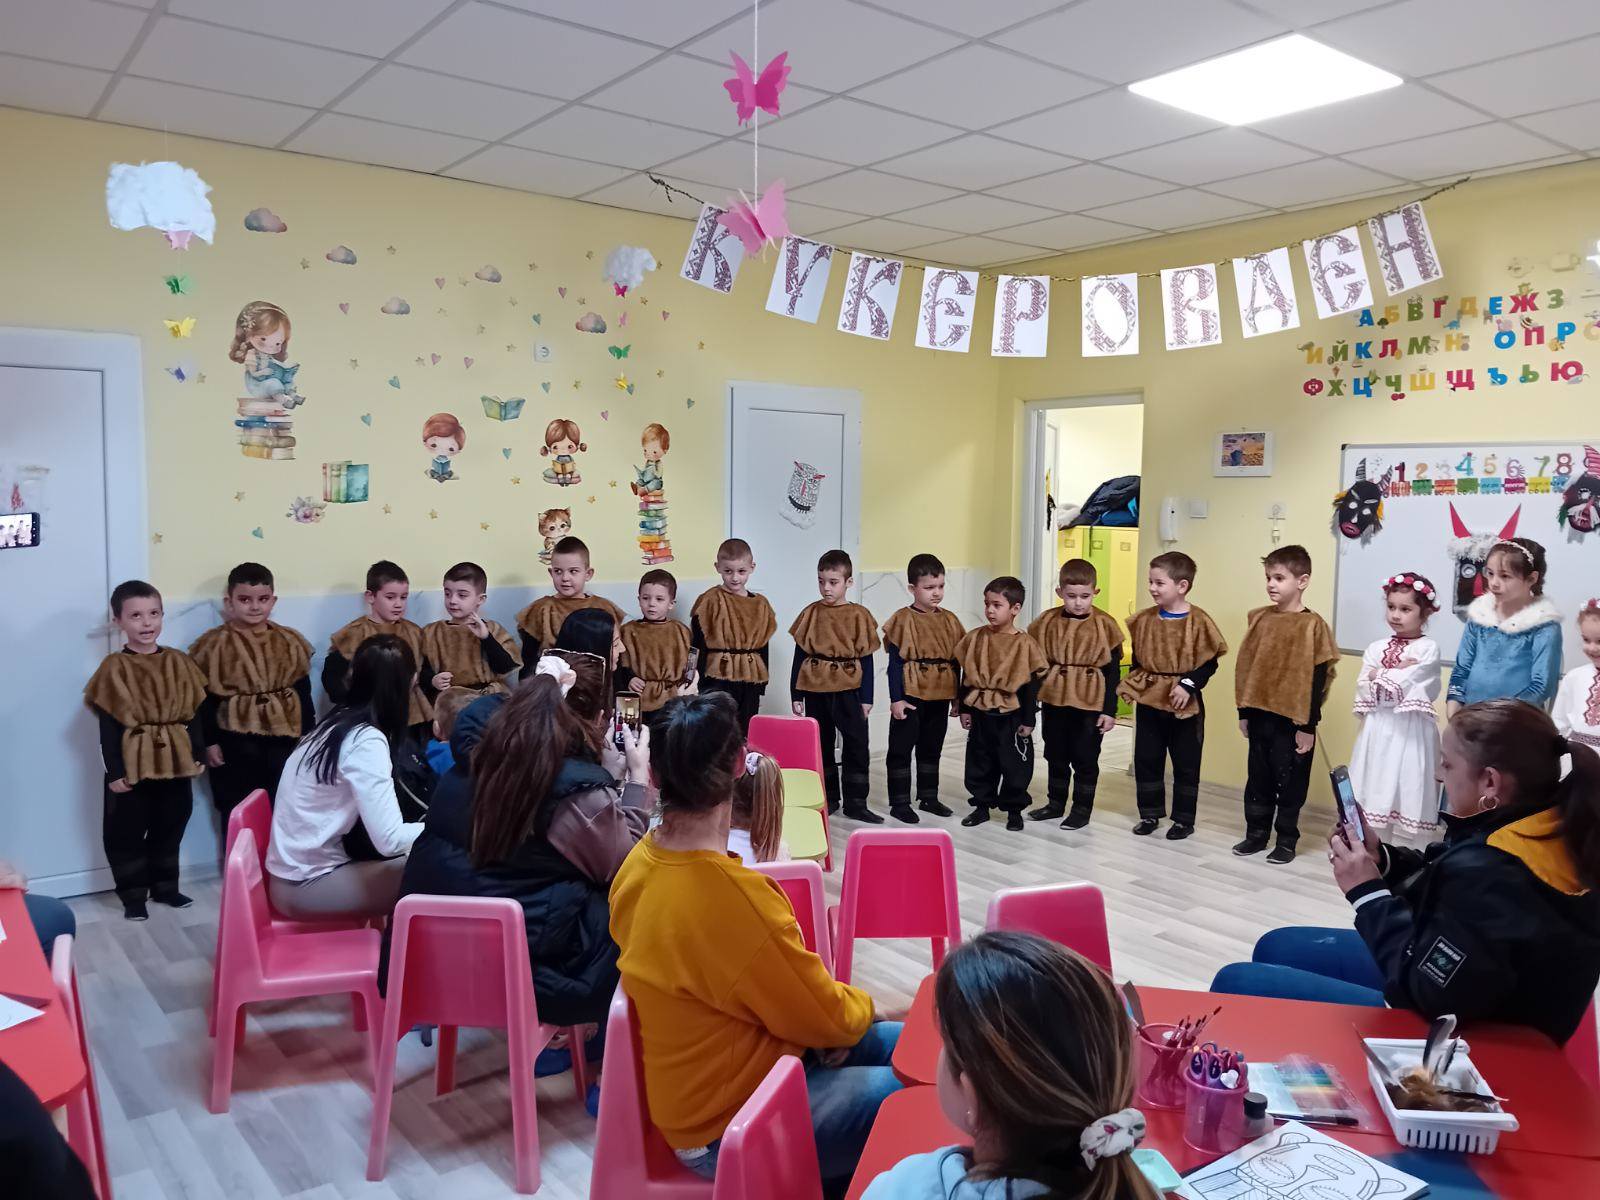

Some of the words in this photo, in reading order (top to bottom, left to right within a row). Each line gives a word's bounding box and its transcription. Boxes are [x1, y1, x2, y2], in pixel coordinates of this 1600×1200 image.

[1358, 309, 1374, 327] А
[1408, 302, 1424, 321] В
[1433, 298, 1448, 318] Г
[1489, 297, 1503, 315] Е
[1509, 292, 1539, 313] Ж
[1356, 342, 1373, 359] К
[1379, 339, 1399, 358] Л
[1407, 336, 1431, 355] М
[1494, 330, 1516, 349] О
[1524, 326, 1545, 346] П
[1557, 322, 1577, 341] Р
[1303, 378, 1324, 396] Ф
[1328, 379, 1344, 396] Х
[1353, 377, 1373, 397] Ц
[1385, 375, 1402, 392] Ч
[1410, 372, 1435, 391] Ш
[1447, 369, 1475, 390] Щ
[1488, 368, 1508, 386] Ъ
[1522, 364, 1540, 384] Ь
[1551, 361, 1584, 383] Ю
[1395, 461, 1405, 482] 1
[1416, 463, 1428, 480] 2
[1455, 452, 1473, 476] 4
[1484, 456, 1497, 475] 5
[1506, 459, 1520, 478] 6
[1534, 456, 1550, 477] 7
[1556, 453, 1572, 476] 8
